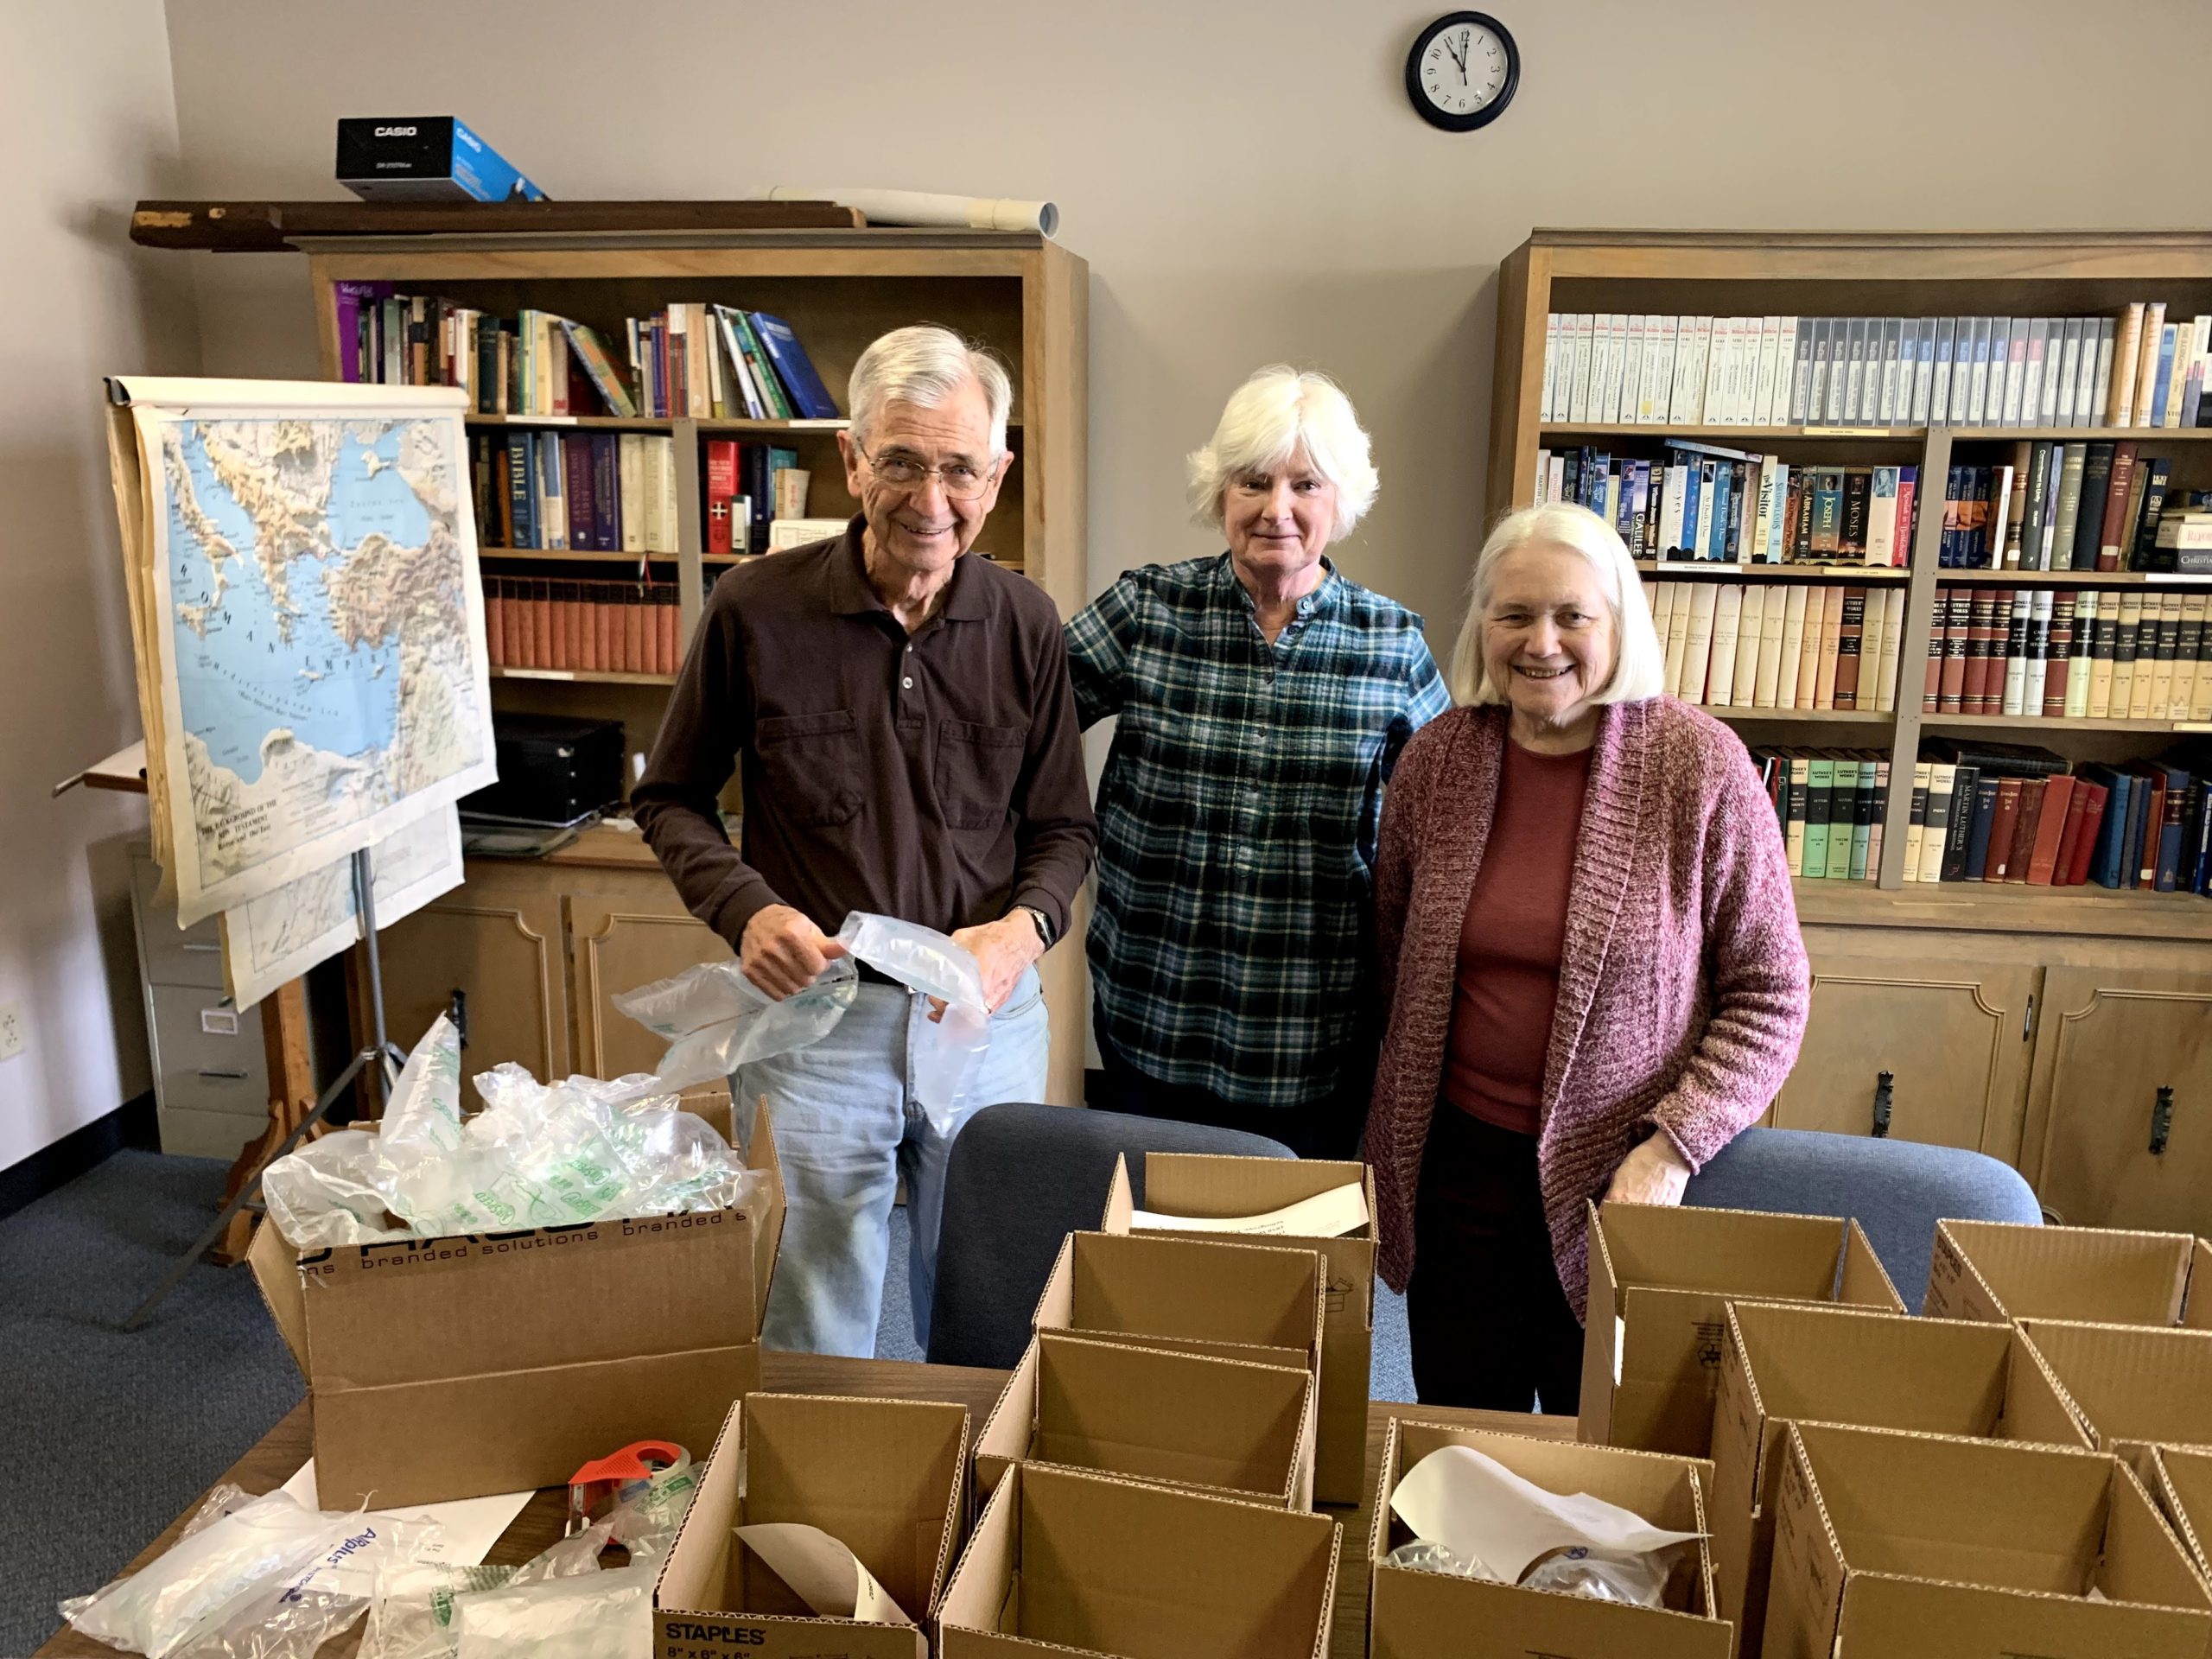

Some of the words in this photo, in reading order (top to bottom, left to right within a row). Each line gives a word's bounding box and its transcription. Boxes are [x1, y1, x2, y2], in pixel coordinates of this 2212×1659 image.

[1460, 30, 1471, 41] 12
[1431, 48, 1442, 60] 10
[1486, 48, 1497, 57] 2
[1431, 84, 1440, 93] 8
[1474, 94, 1483, 104] 5
[1443, 95, 1452, 105] 7
[1459, 99, 1465, 108] 6
[374, 127, 417, 137] CASIO
[511, 448, 526, 500] BIBLE
[1674, 496, 1682, 513] yes
[1759, 483, 1774, 518] Visitor
[1801, 496, 1813, 534] ABRAHAM
[1821, 496, 1836, 529] JOSEPH
[1849, 501, 1861, 537] MOSES
[1633, 513, 1645, 555] GALILEE
[1961, 785, 1972, 814] MARTIN
[234, 814, 269, 833] TESTAMENT
[1956, 816, 1967, 851] LUTHER'S
[475, 1192, 513, 1223] AIRSPEED
[623, 1212, 721, 1236] branded
[361, 1246, 467, 1270] branded
[481, 1230, 599, 1255] solutions
[665, 1623, 766, 1645] STAPLES
[667, 1647, 684, 1658] 8"
[700, 1649, 717, 1659] 6"
